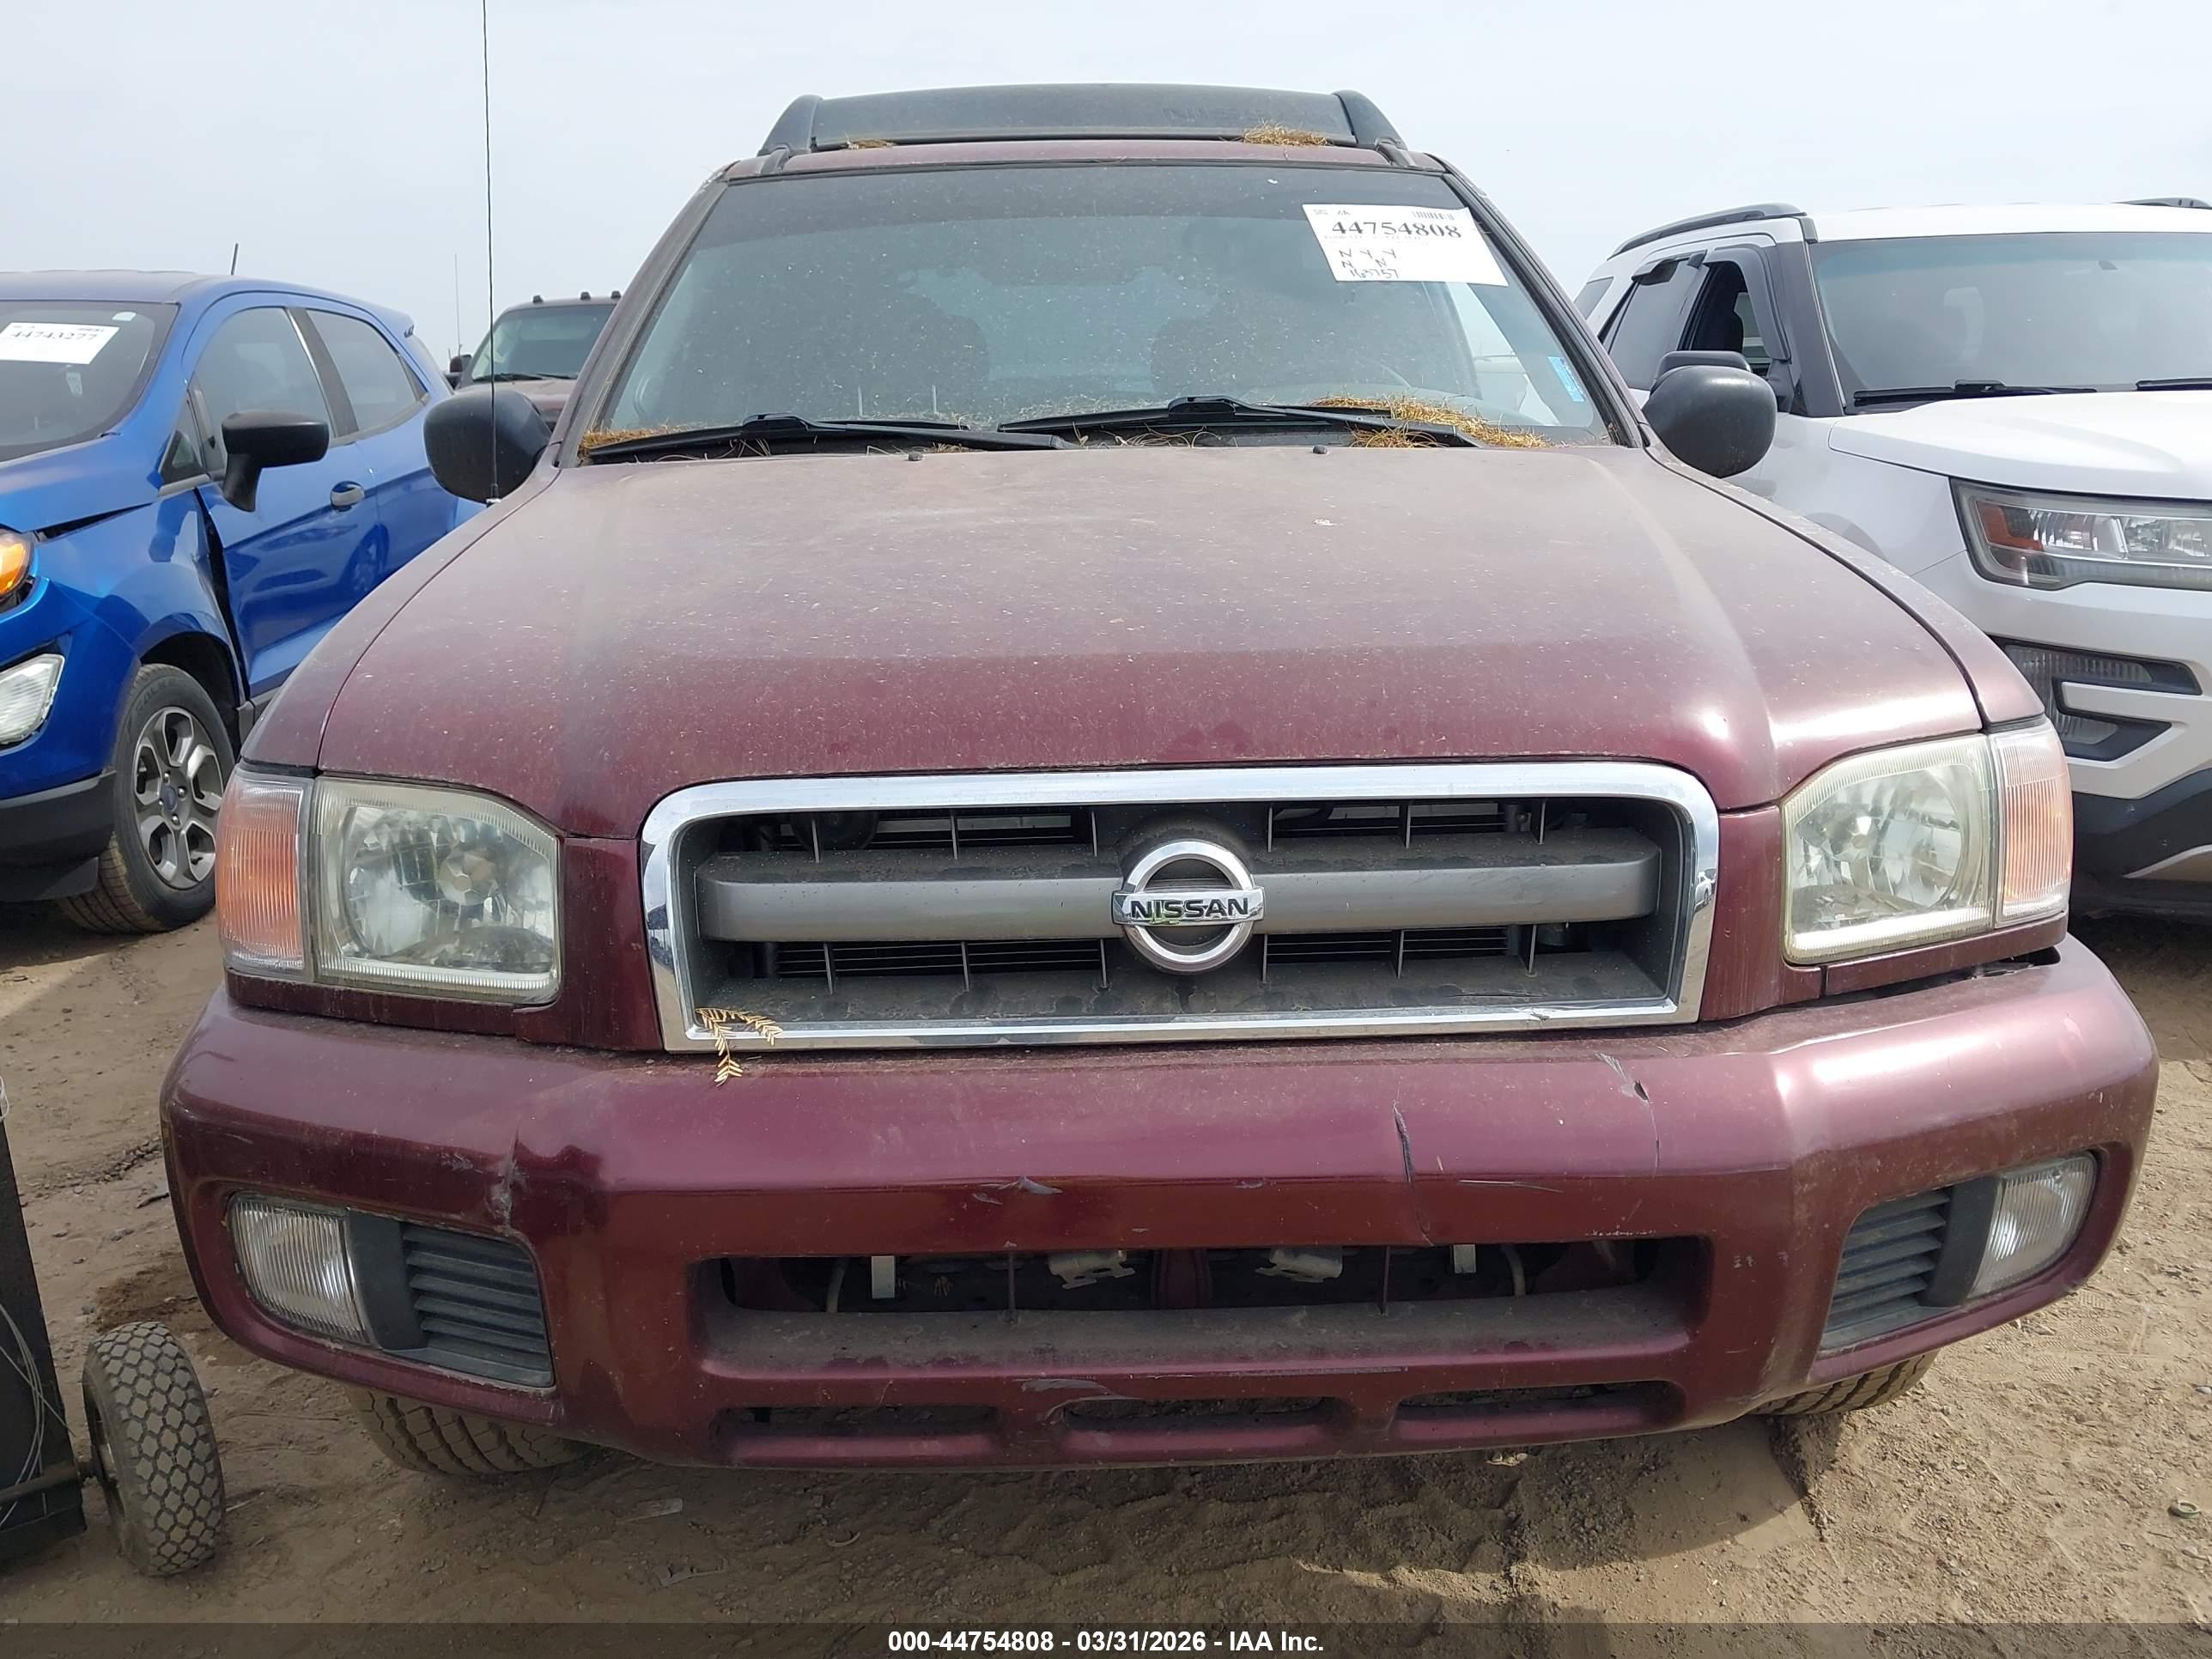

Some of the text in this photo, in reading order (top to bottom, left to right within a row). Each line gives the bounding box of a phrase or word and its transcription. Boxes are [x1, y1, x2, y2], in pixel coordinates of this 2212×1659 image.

[1332, 221, 1462, 239] 44754808
[1339, 248, 1352, 258] N
[1130, 897, 1249, 919] NISSAN
